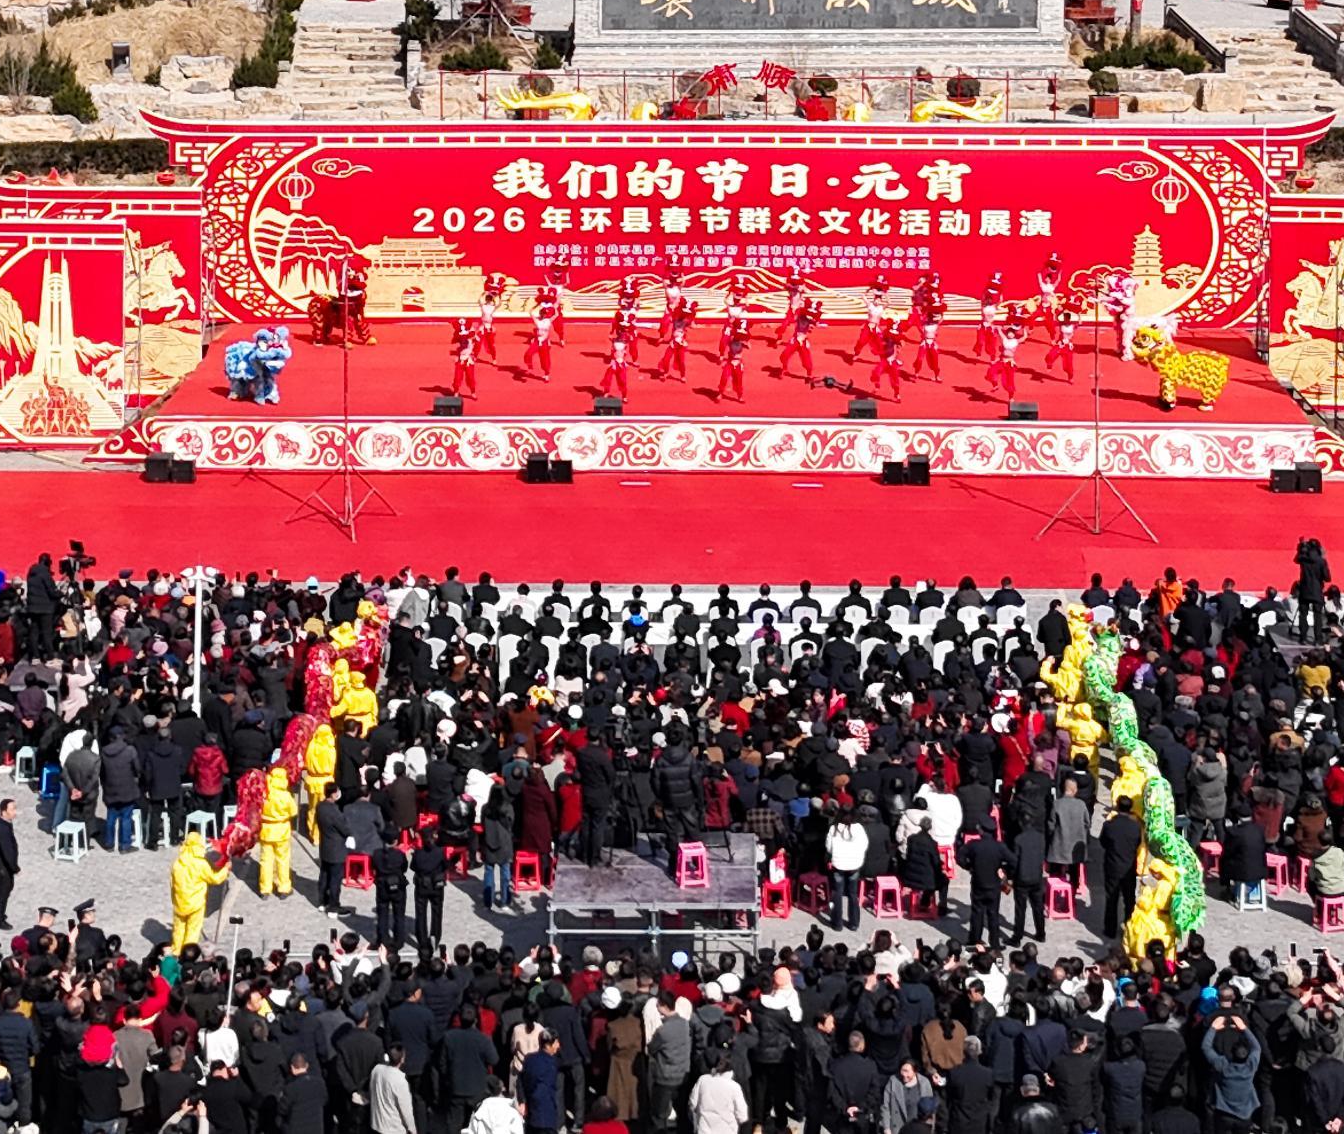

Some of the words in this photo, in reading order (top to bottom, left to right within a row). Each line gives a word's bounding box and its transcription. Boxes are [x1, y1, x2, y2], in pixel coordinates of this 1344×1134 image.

[492, 157, 973, 202] 我们的节日·元宵
